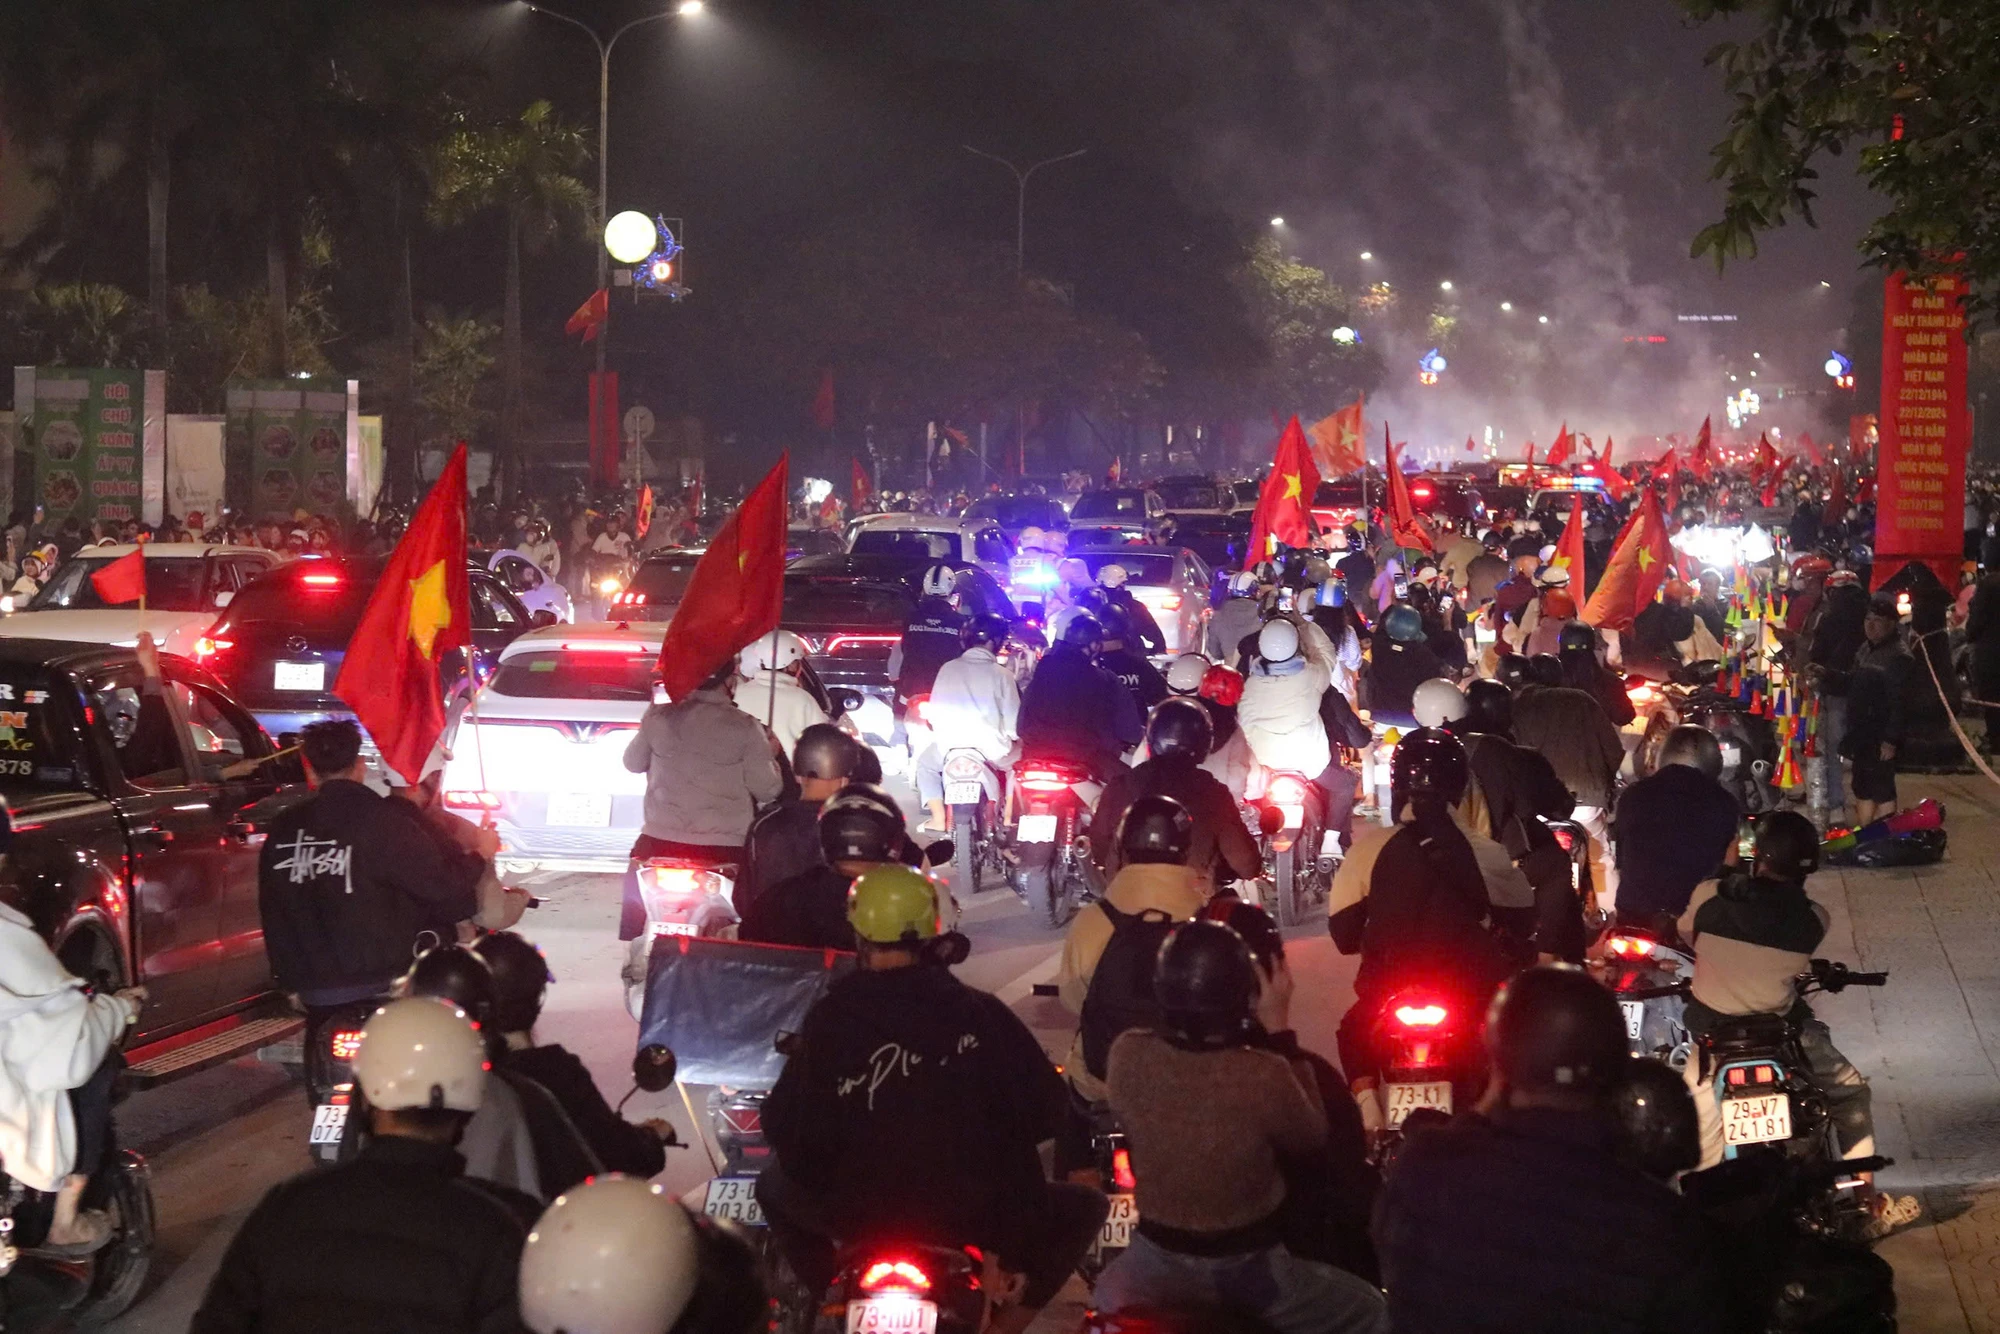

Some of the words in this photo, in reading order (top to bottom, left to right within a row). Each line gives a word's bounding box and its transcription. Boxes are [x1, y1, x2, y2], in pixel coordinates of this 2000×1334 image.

[1396, 1086, 1441, 1105] 73-K1
[1731, 1097, 1778, 1120] 29-V7
[1728, 1117, 1786, 1141] 241.81
